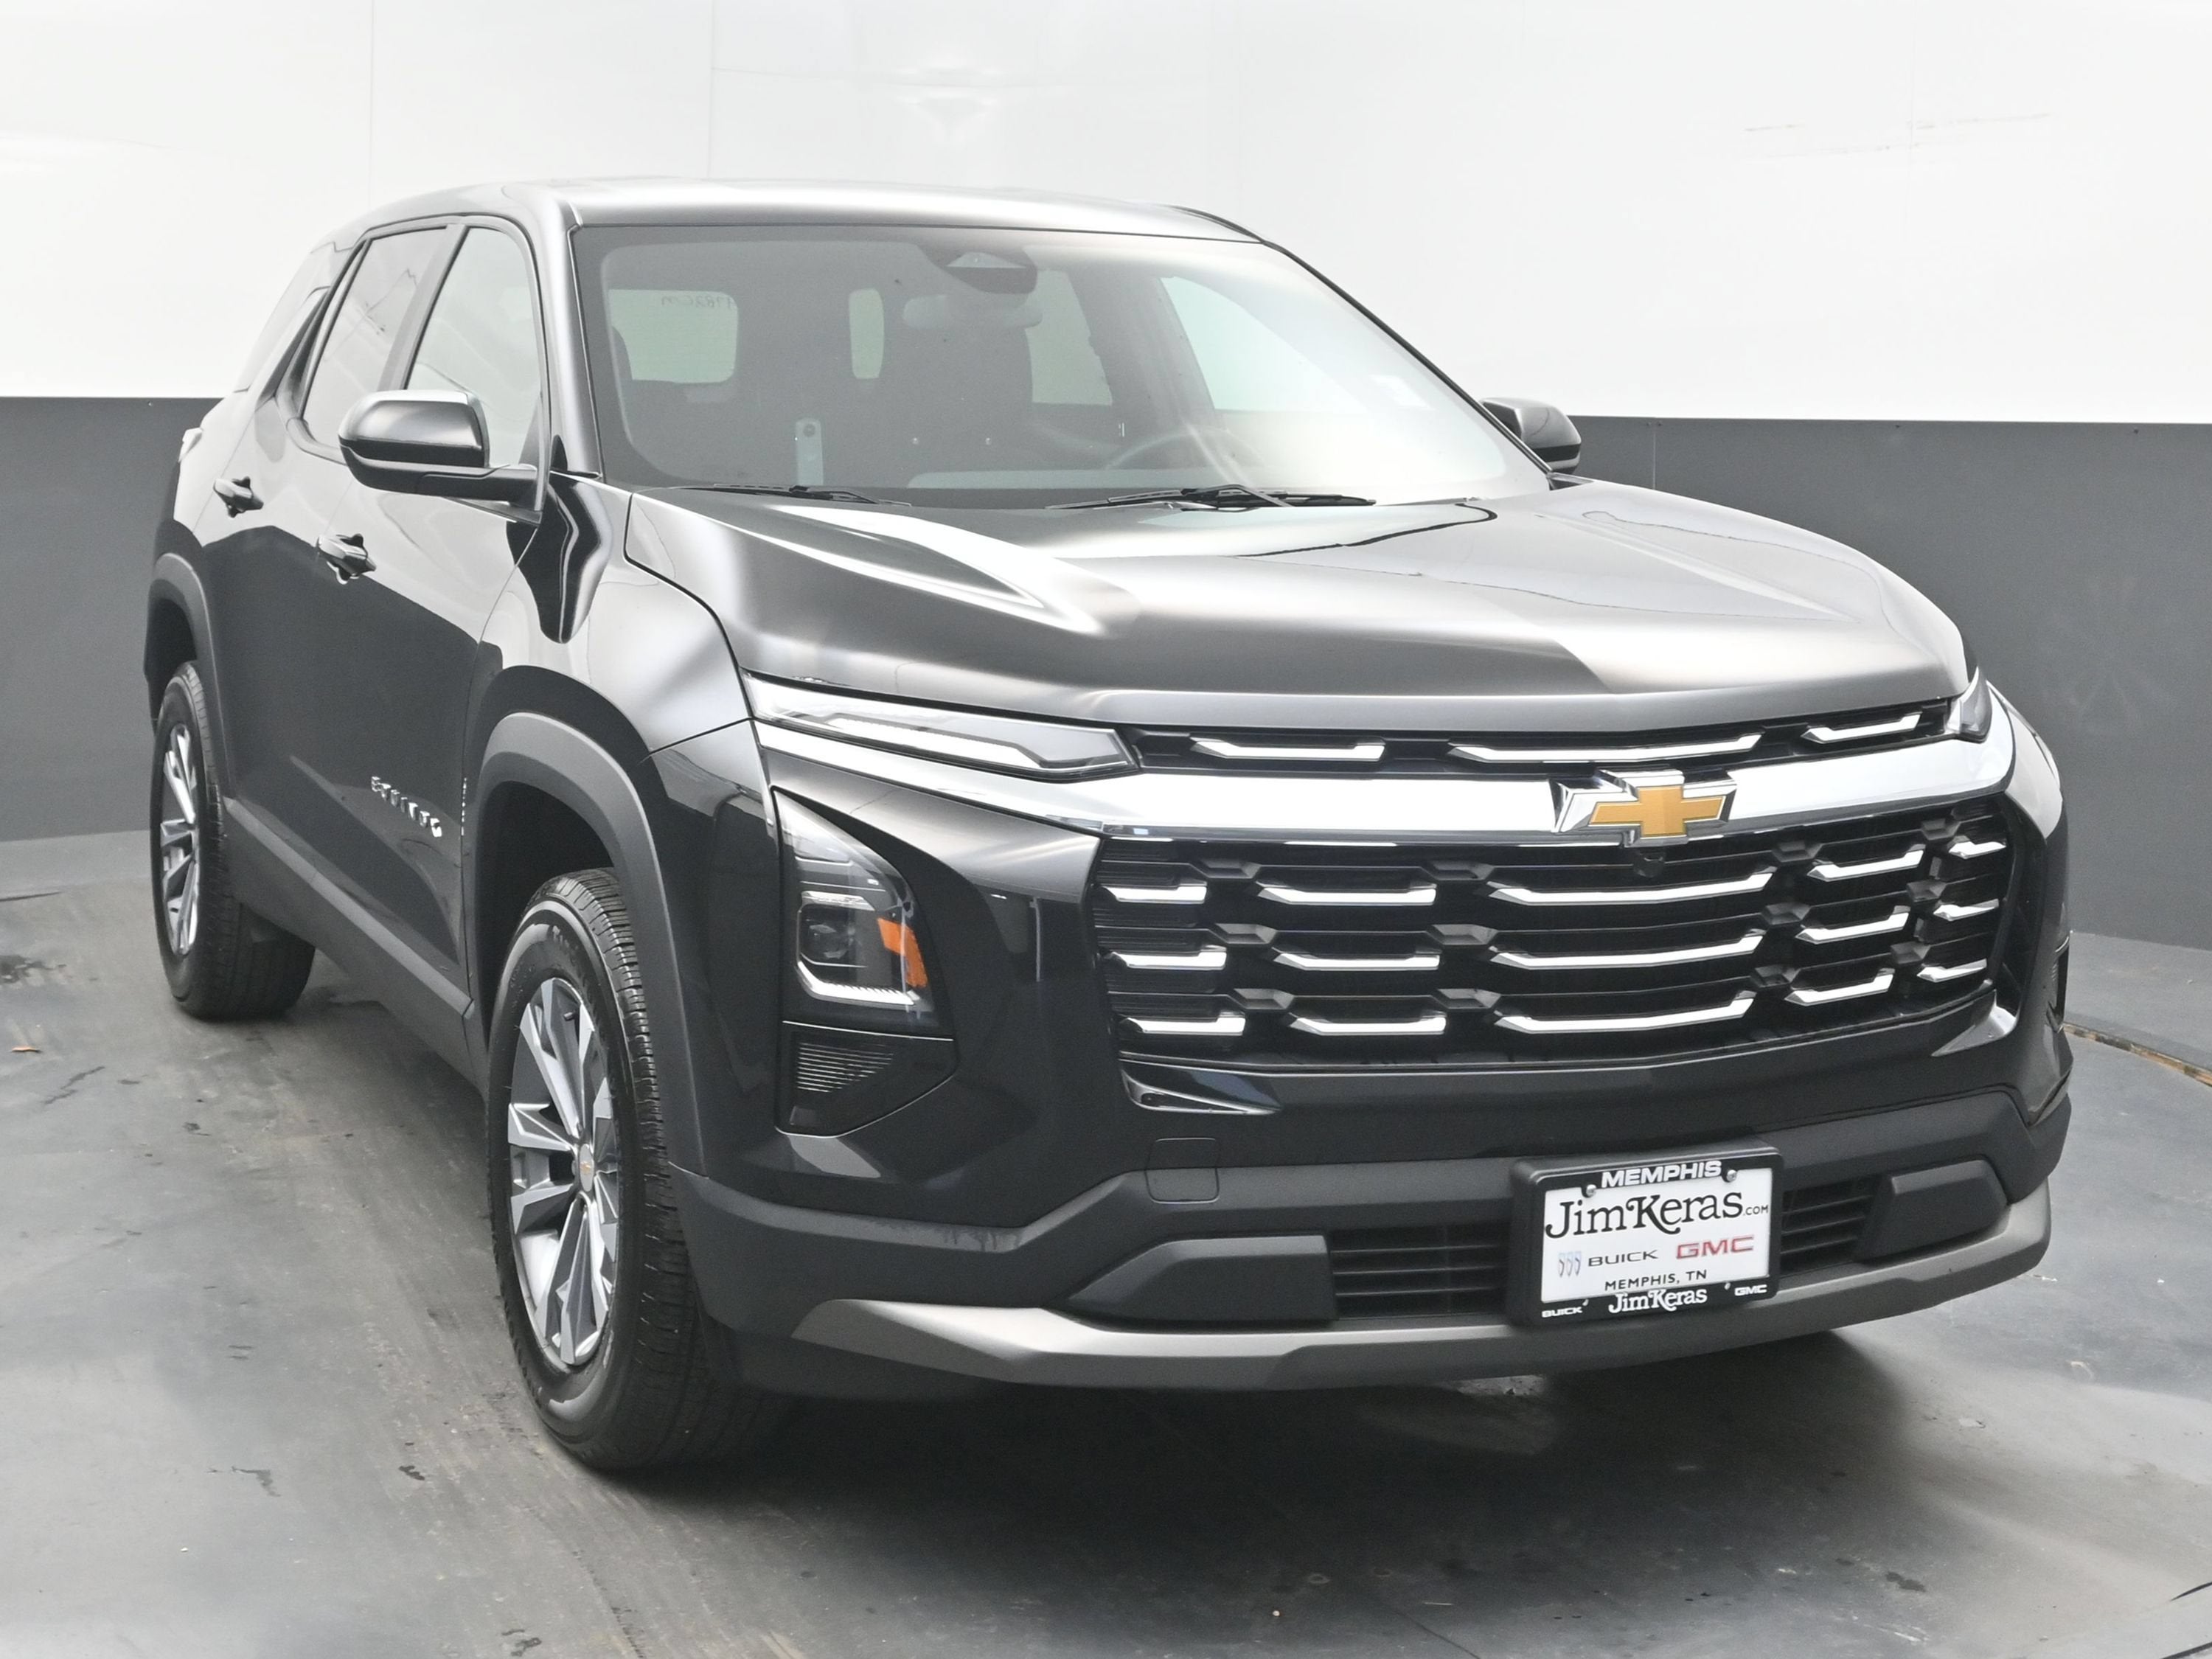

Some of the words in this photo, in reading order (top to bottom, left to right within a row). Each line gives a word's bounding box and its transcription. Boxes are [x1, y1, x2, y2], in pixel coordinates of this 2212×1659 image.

[1601, 1160, 1722, 1189] MEMPHIS
[1587, 1250, 1658, 1267] BUICK
[1676, 1234, 1755, 1260] GMC
[1604, 1273, 1680, 1291] MEMPHIS,
[1686, 1269, 1708, 1281] TN
[1541, 1305, 1583, 1318] BUICK
[1734, 1284, 1767, 1296] GMC
